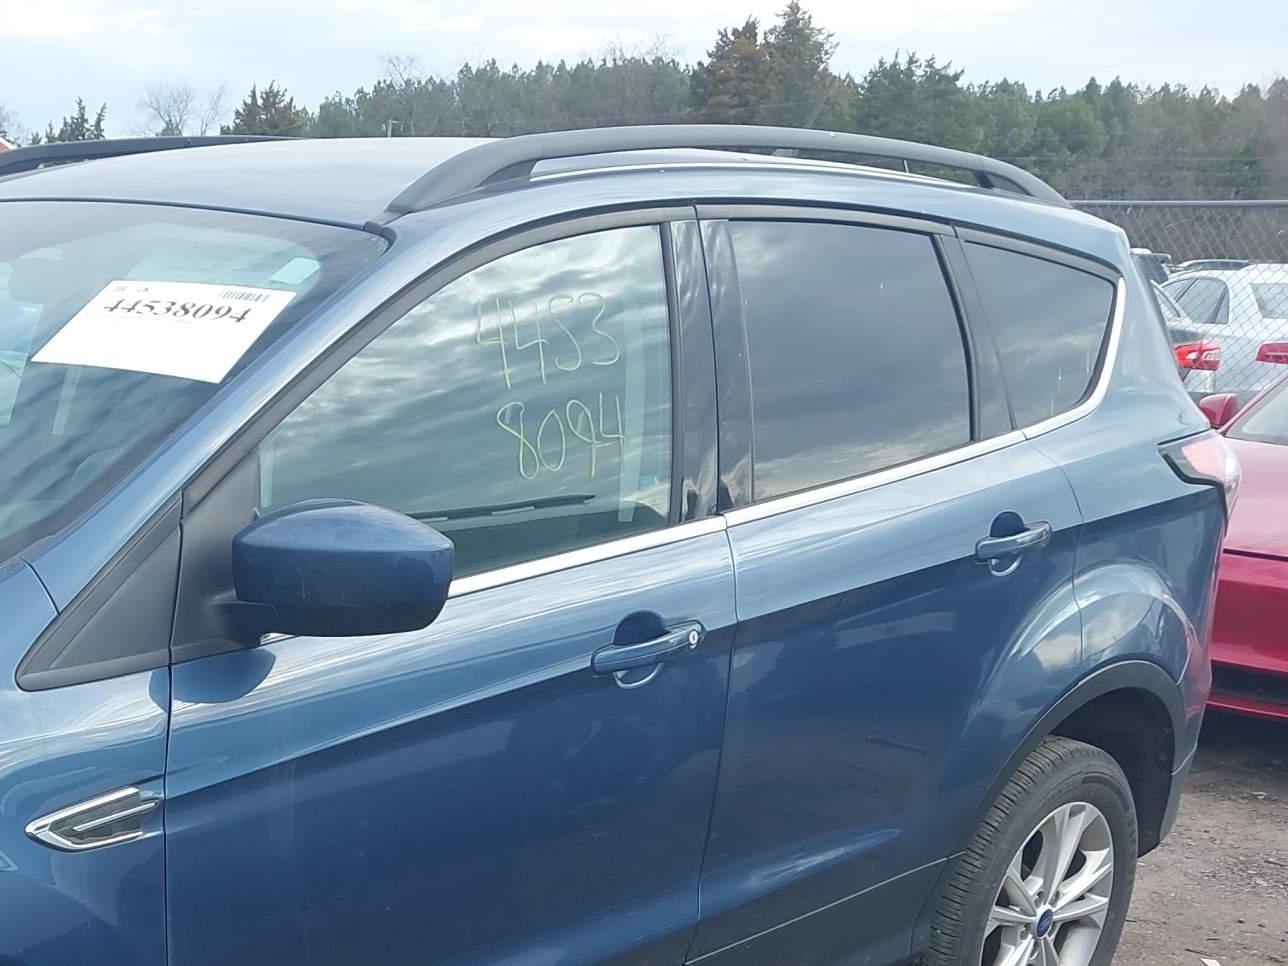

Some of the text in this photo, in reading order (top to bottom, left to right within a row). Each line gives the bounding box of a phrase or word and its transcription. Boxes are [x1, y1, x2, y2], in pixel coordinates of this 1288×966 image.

[103, 298, 252, 323] 44538094
[475, 291, 620, 390] 4453
[496, 391, 625, 479] 8094
